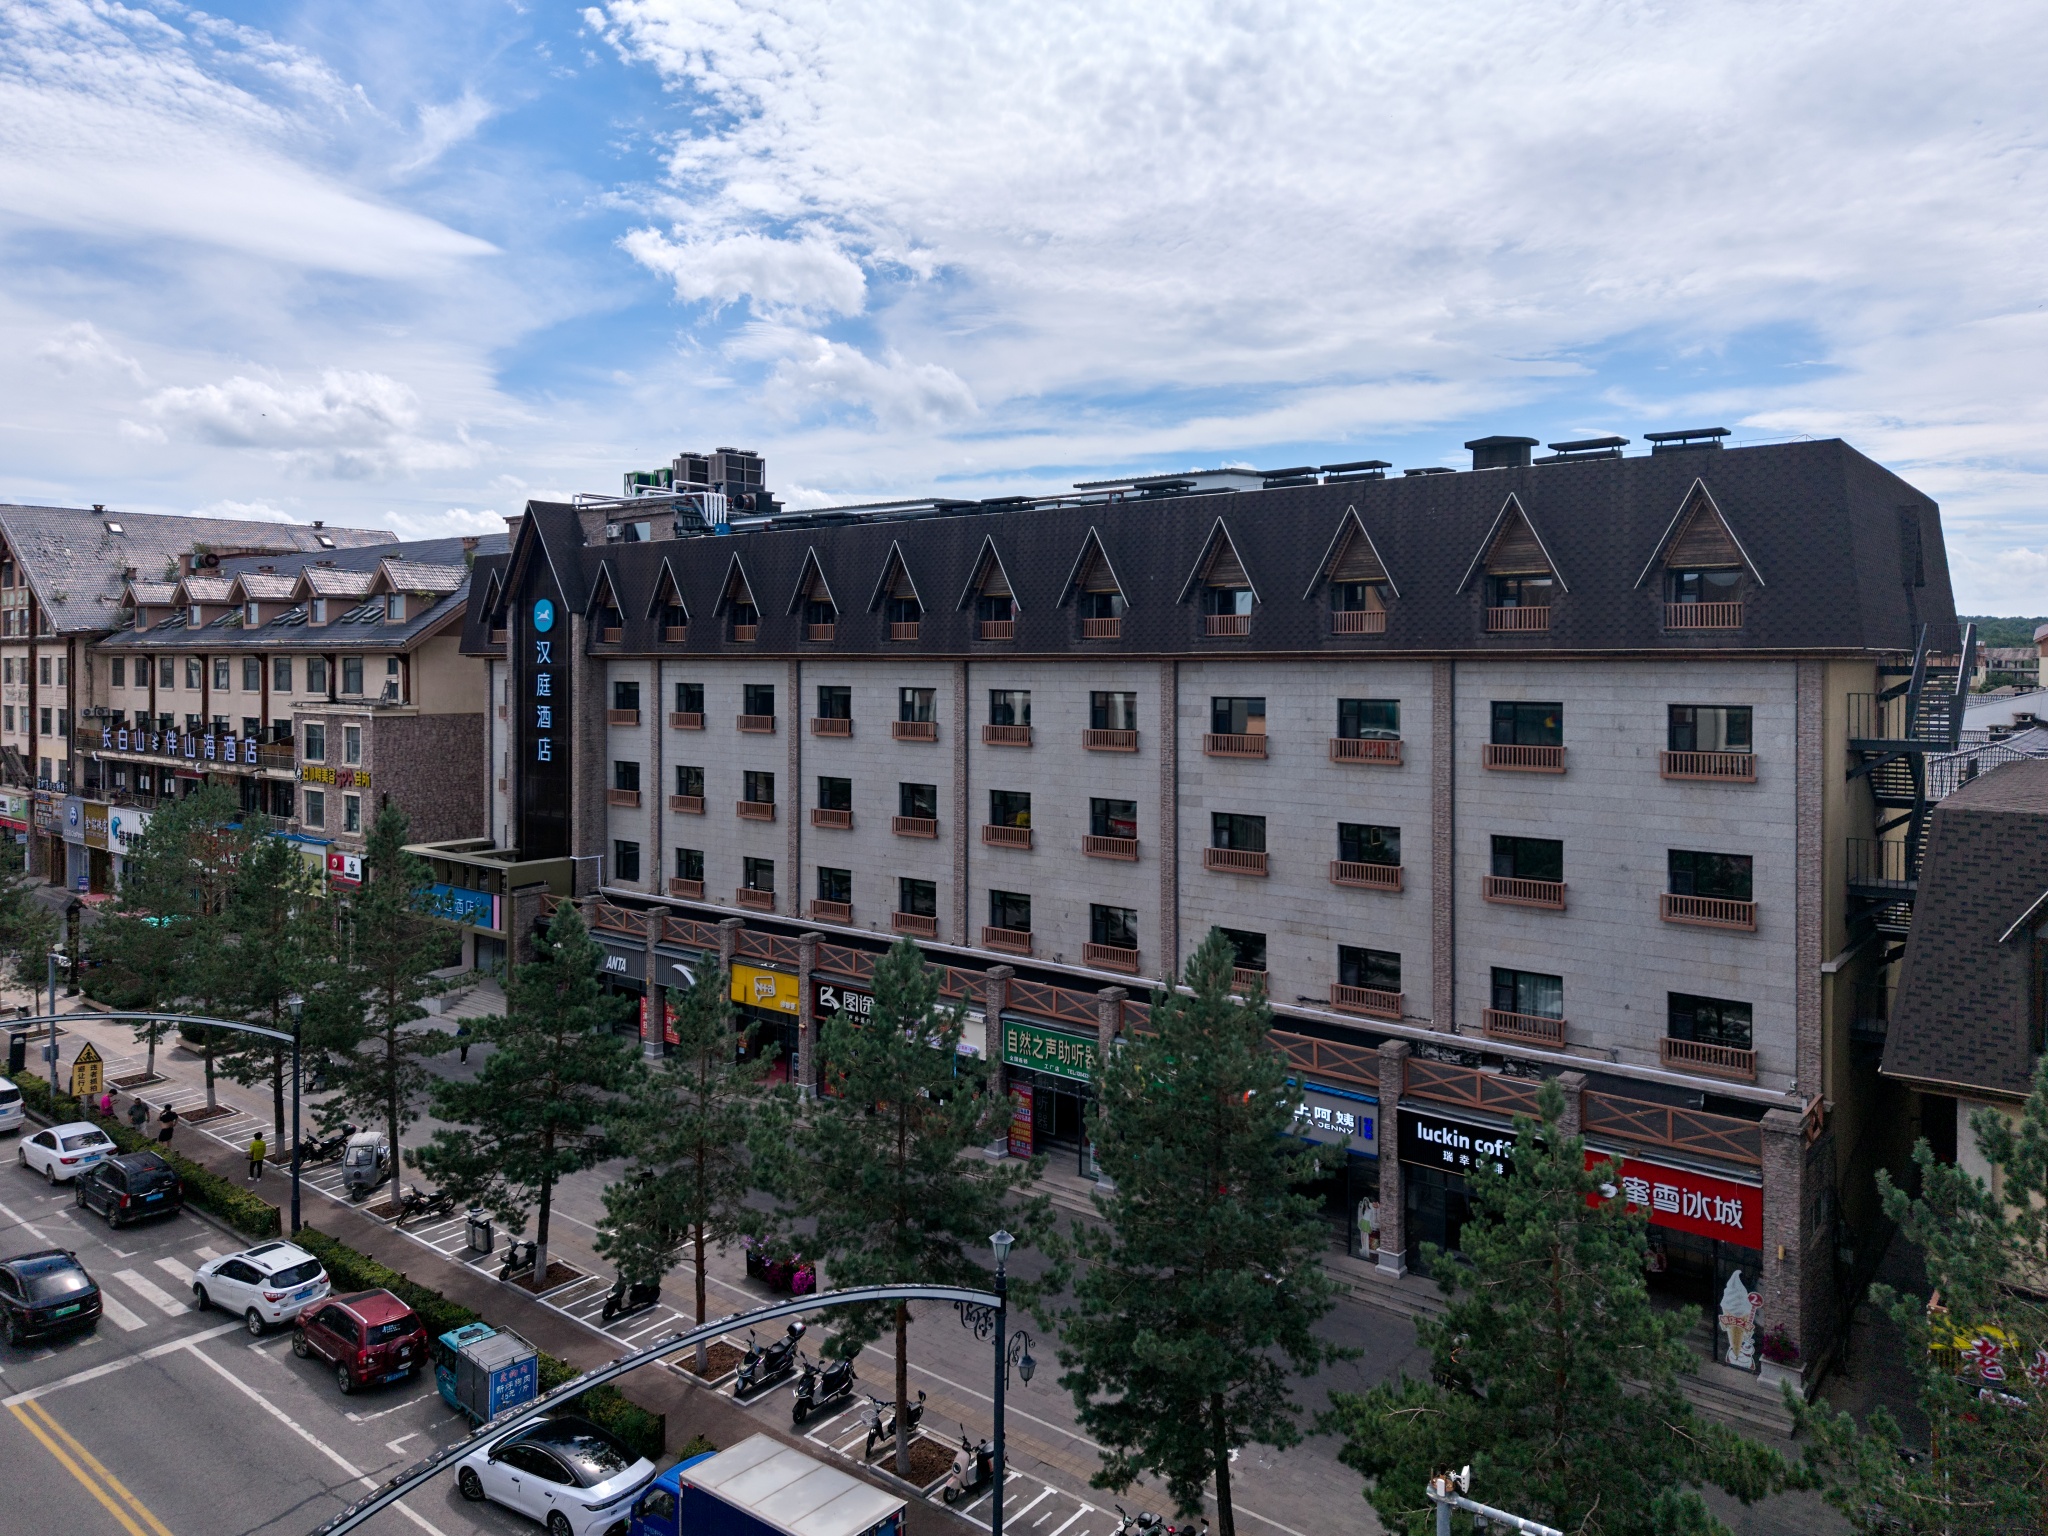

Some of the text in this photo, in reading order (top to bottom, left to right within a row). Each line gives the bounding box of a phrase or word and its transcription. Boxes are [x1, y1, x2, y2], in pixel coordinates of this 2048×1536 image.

[536, 640, 552, 761] 汉庭酒店
[102, 725, 145, 752] 长白山
[606, 955, 627, 972] ANTA
[843, 991, 875, 1015] 图途
[1007, 1029, 1097, 1069] 自然之声助听器
[1317, 1121, 1354, 1135] JENNY
[1417, 1121, 1470, 1149] luckin
[1622, 1176, 1743, 1230] 蜜雪冰城
